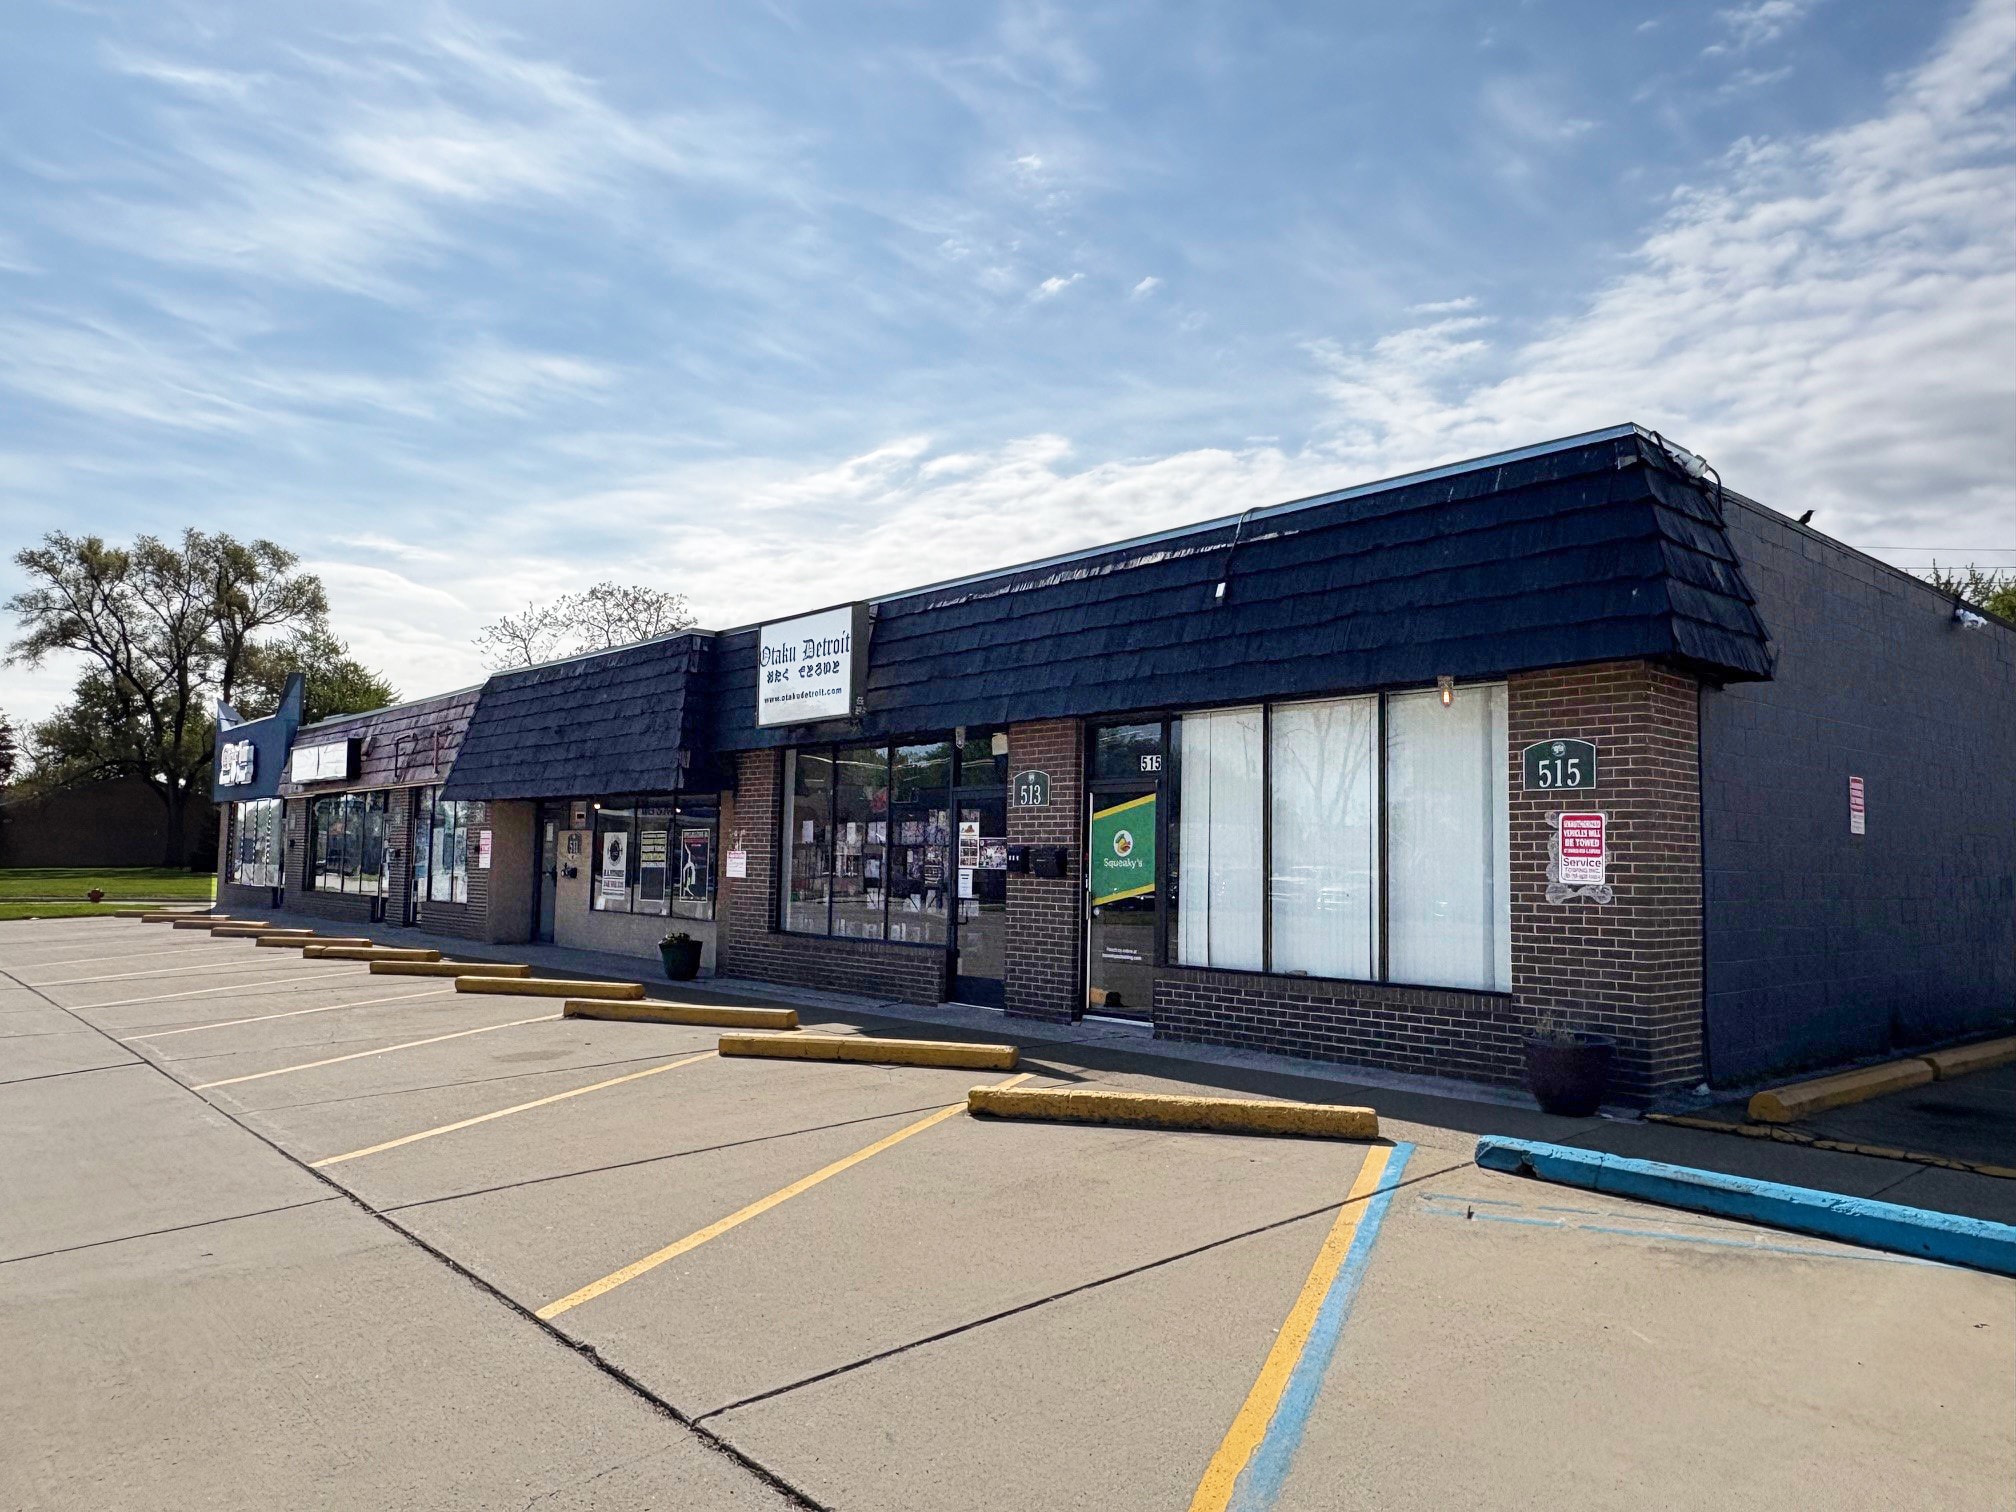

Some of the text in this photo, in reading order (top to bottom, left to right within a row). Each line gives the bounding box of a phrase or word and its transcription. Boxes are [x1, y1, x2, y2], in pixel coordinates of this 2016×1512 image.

[760, 630, 851, 667] Otaku Detroit
[764, 687, 842, 704] www.otakudetroit.com
[1141, 755, 1161, 771] 515
[1538, 758, 1581, 788] 515
[1020, 784, 1042, 806] 513
[1564, 838, 1600, 847] BE TOWED
[1103, 857, 1143, 869] Squeaky's
[1563, 857, 1602, 867] Service
